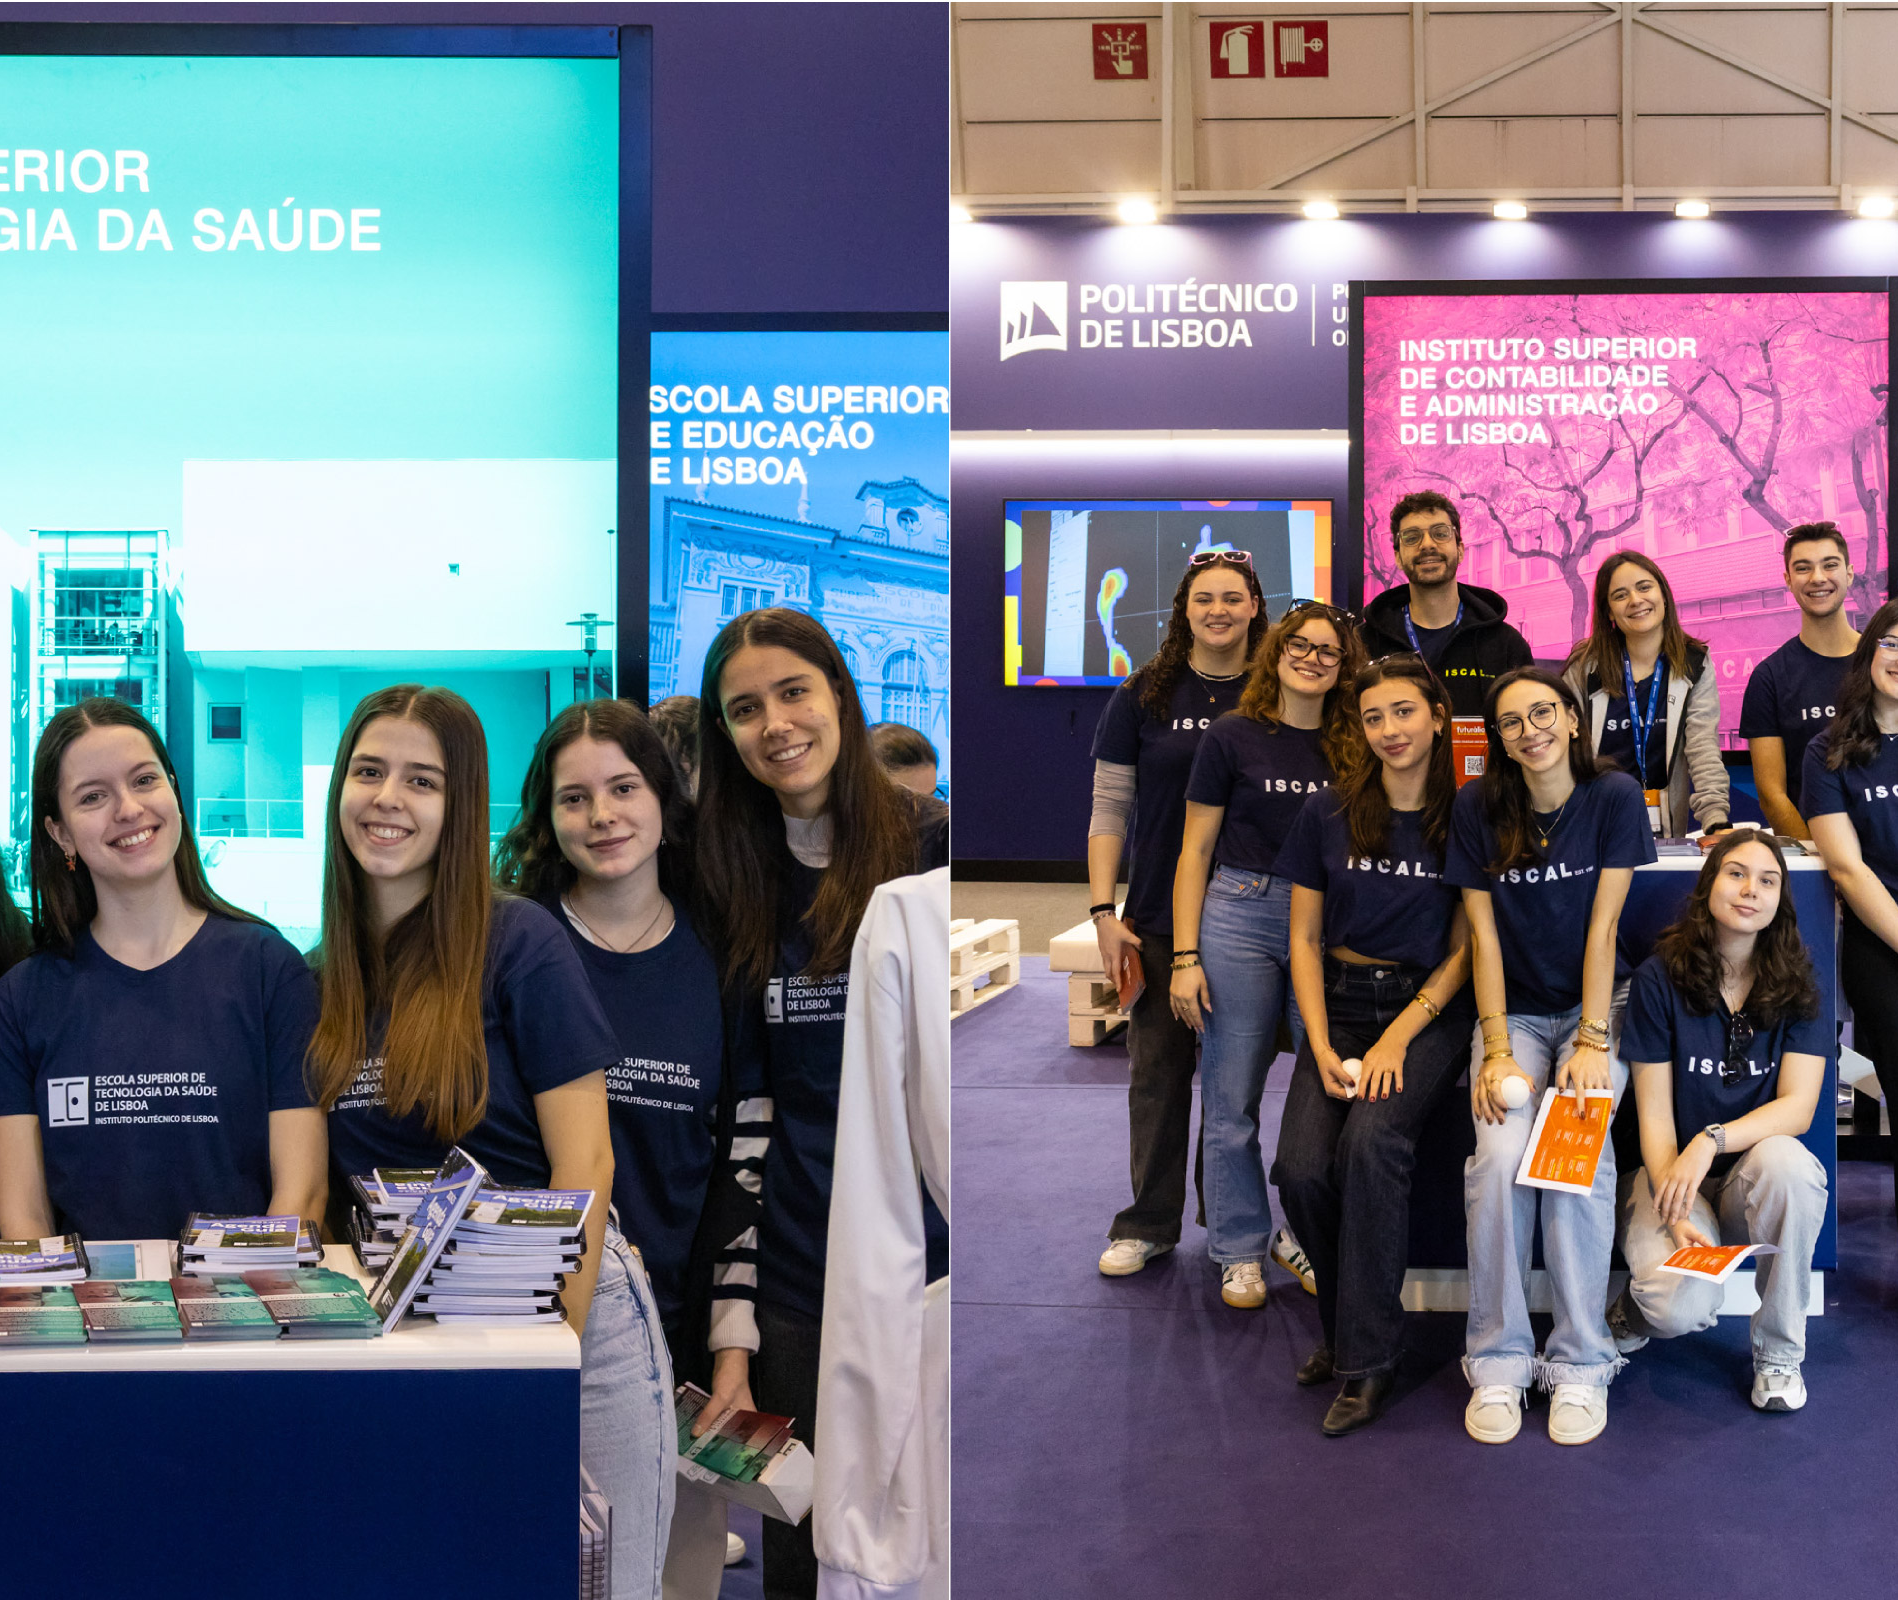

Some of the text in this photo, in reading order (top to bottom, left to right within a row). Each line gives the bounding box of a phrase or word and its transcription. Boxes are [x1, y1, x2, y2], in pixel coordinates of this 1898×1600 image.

[98, 207, 174, 251] DA
[191, 197, 381, 252] SAÚDE
[1080, 278, 1297, 313] POLITÉCNICO
[1080, 319, 1252, 348] DE LISBOA
[1400, 338, 1696, 362] INSTITUTO SUPERIOR
[1400, 366, 1668, 389] DE CONTABILIDADE
[773, 385, 949, 413] SUPERIOR
[1401, 389, 1658, 421] E ADMINISTRAÇÃO
[683, 415, 874, 456] EDUCAÇÃO
[1400, 422, 1547, 444] DE LISBOA
[683, 457, 807, 485] LISBOA
[1445, 668, 1485, 678] ISCAL
[1347, 856, 1425, 877] ISCAL
[1500, 862, 1573, 883] ISCAL
[787, 985, 842, 998] TECNOLOGIA
[787, 999, 831, 1010] DE LISBOA
[625, 1057, 690, 1074] SUPERIOR DE
[95, 1073, 205, 1086] ESCOLA SUPERIOR DE
[650, 1072, 700, 1089] DA SAÚDE
[95, 1084, 217, 1098] TECNOLOGIA DA SAÚDE
[95, 1100, 148, 1111] DE LISBOA
